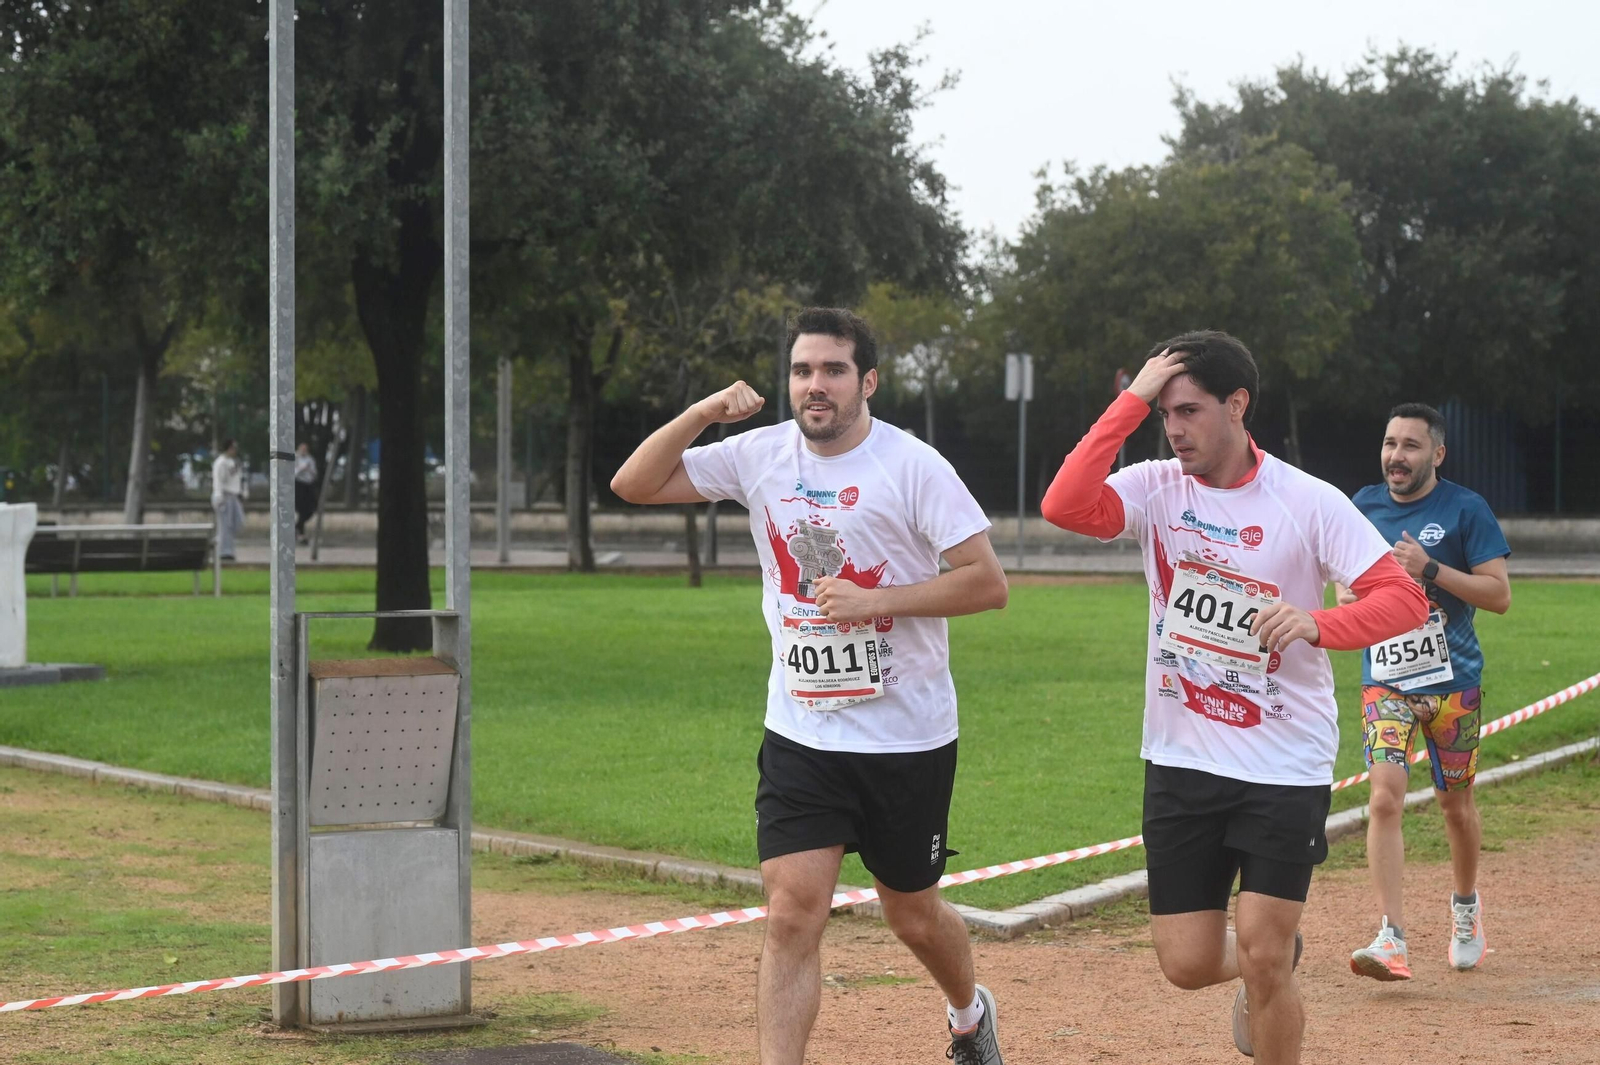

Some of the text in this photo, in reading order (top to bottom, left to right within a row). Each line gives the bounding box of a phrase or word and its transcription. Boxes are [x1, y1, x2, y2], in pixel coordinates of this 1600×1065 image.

[840, 490, 857, 502] aje
[1241, 530, 1261, 542] aje
[1418, 530, 1445, 540] SPG
[1244, 585, 1258, 595] aje
[1174, 588, 1258, 637] 4014
[837, 623, 850, 632] aje
[1376, 637, 1435, 666] 4554
[788, 644, 863, 675] 4011
[882, 676, 898, 684] DECO
[1203, 704, 1244, 722] SERIES
